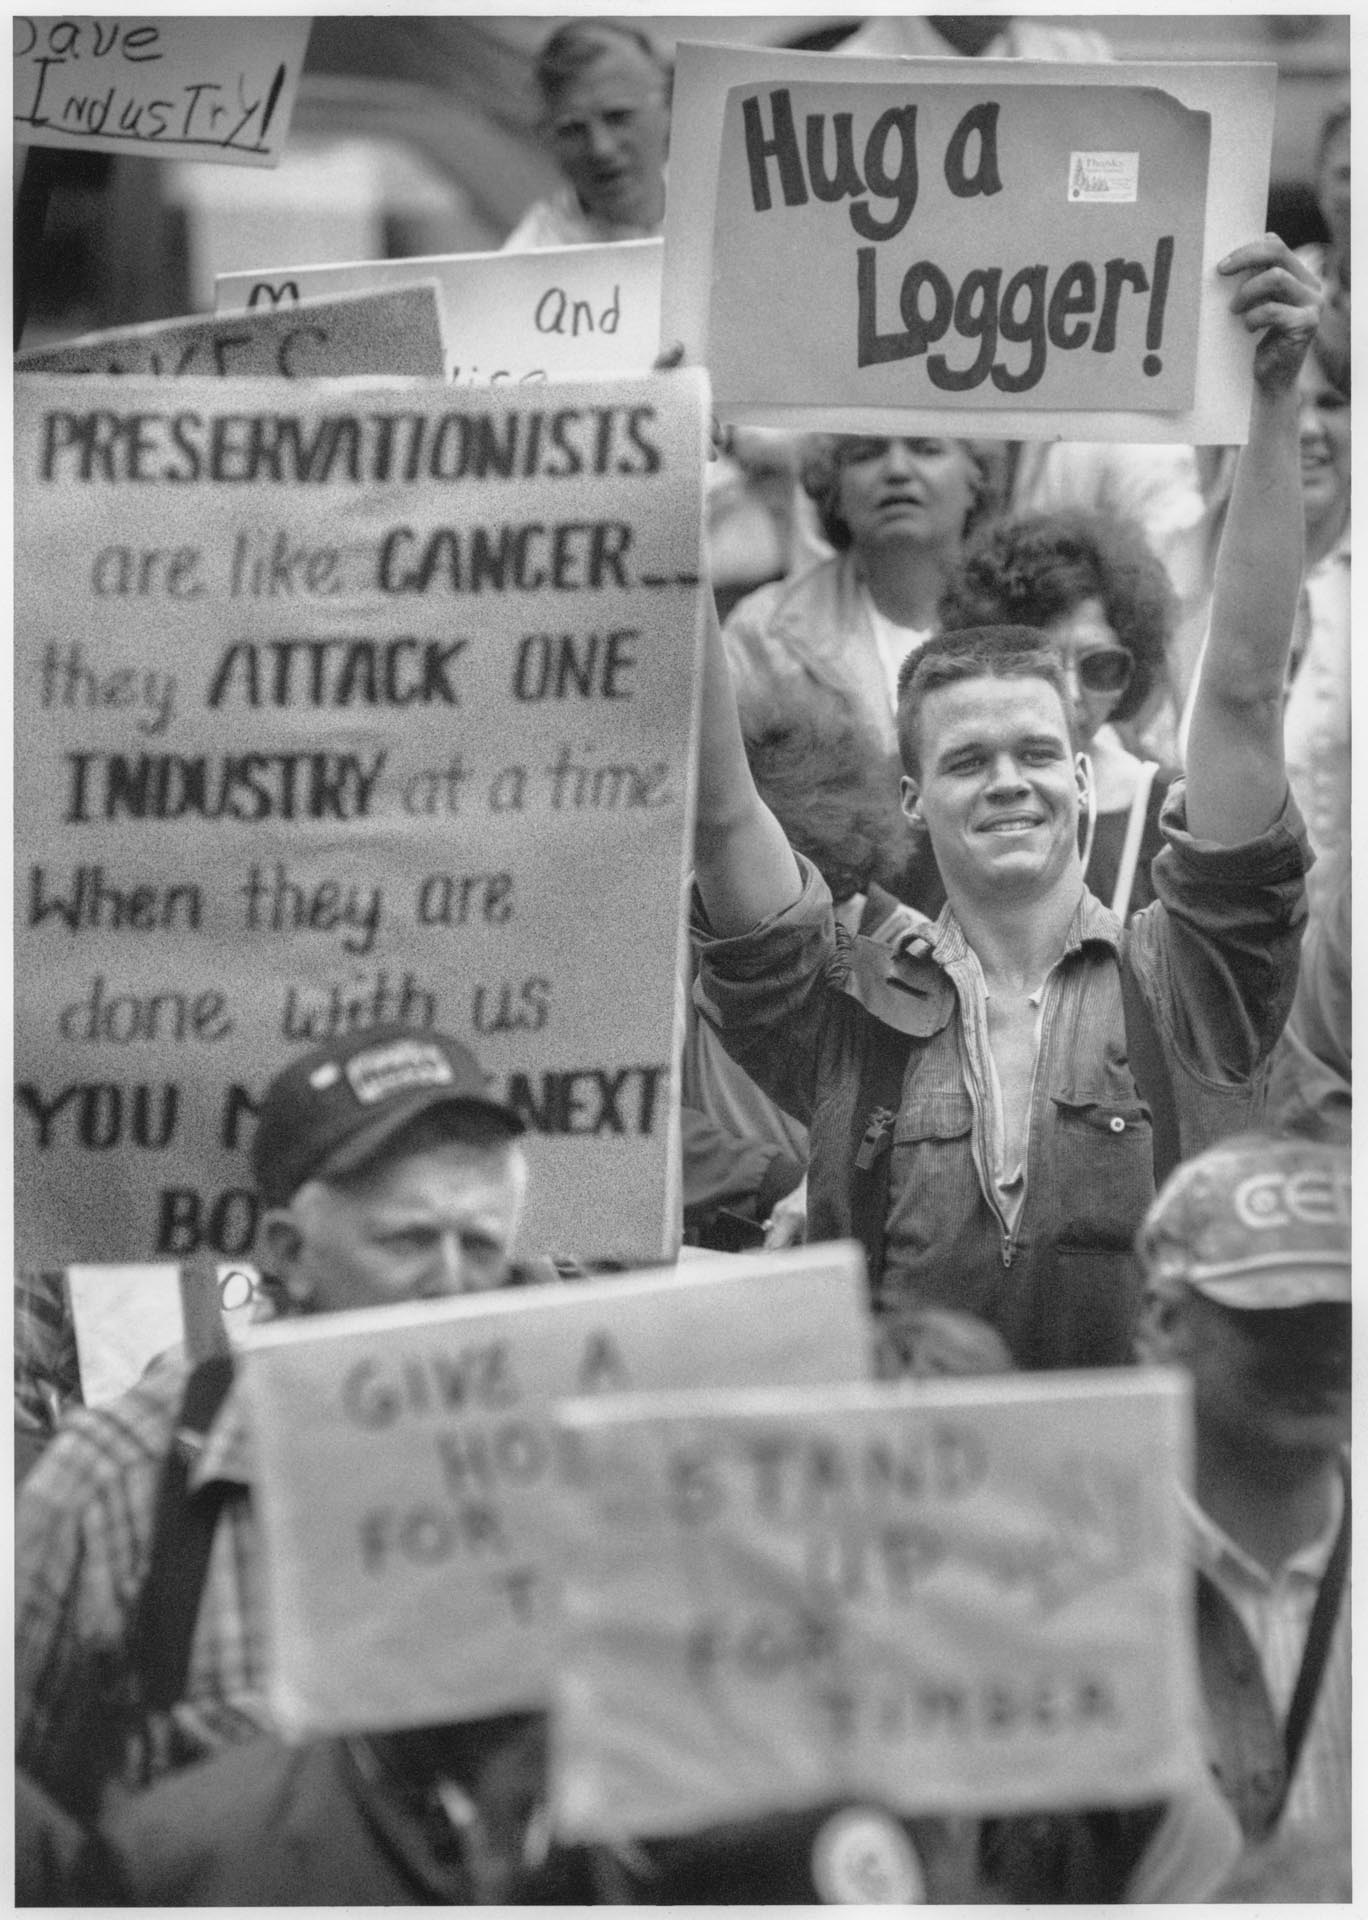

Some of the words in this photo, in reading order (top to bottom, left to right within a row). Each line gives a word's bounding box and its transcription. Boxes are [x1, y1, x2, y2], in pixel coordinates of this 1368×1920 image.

[742, 88, 919, 241] Hug
[943, 102, 1004, 199] a
[534, 284, 621, 337] and
[856, 235, 1176, 393] Logger!
[40, 403, 664, 484] PRESERVATIONISTS
[91, 543, 205, 601] are
[230, 528, 344, 600] like
[40, 638, 179, 737] they
[205, 636, 470, 709] ATTACK
[513, 626, 644, 702] ONE
[63, 748, 389, 825] INDUSTRY
[402, 755, 476, 817] at
[489, 762, 528, 812] a
[548, 742, 678, 812] time
[27, 863, 202, 934] When
[238, 862, 384, 956] they
[416, 868, 516, 928] are
[58, 975, 234, 1045] done
[279, 968, 437, 1044] with
[471, 975, 553, 1034] us
[13, 1080, 181, 1151] YOU
[507, 1062, 672, 1138] NEXT
